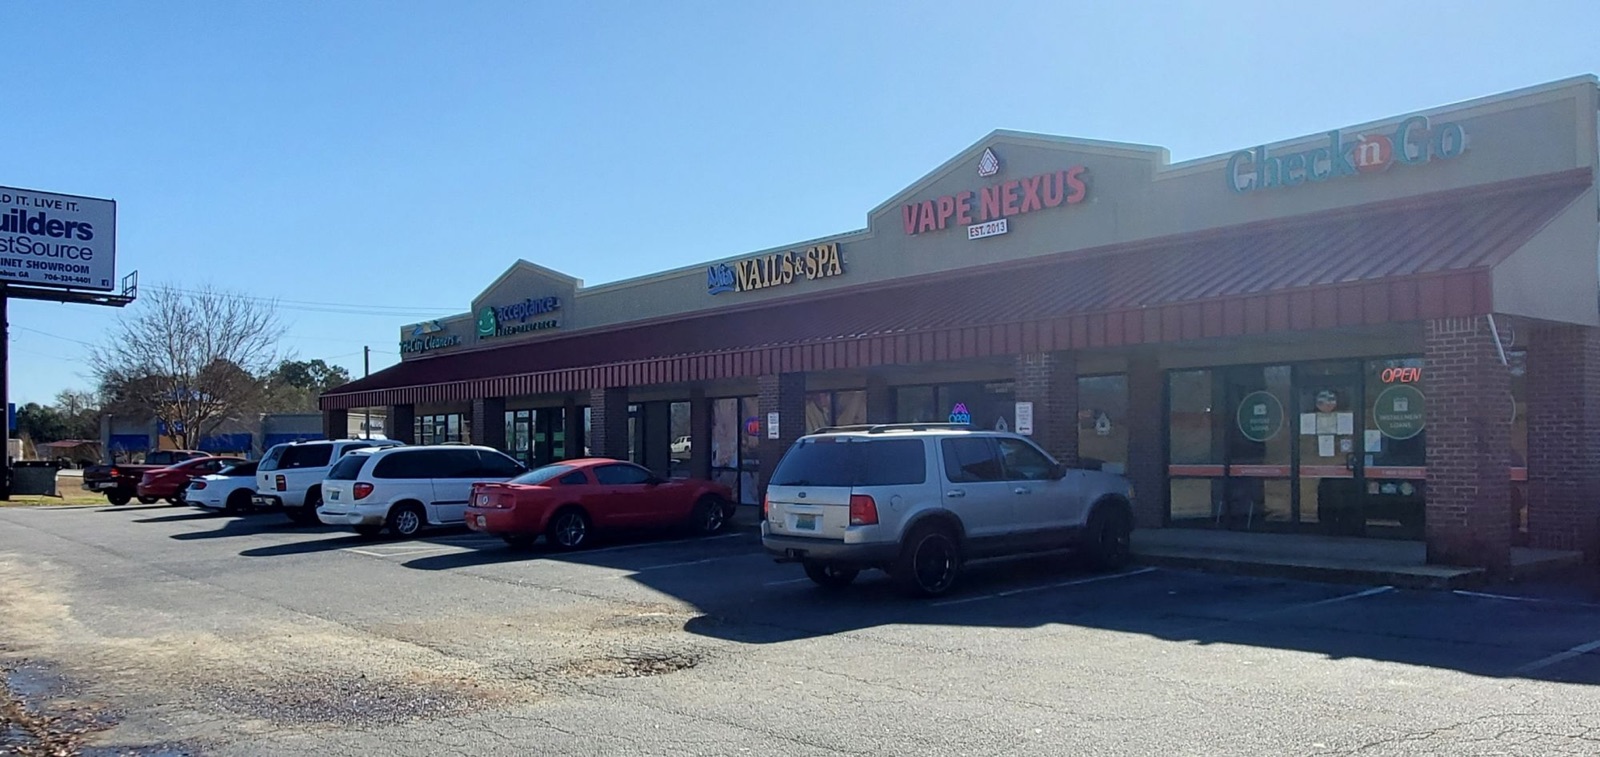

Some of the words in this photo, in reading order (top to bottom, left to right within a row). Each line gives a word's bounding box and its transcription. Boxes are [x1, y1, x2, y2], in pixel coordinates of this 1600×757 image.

[1226, 129, 1359, 194] Check
[1396, 115, 1466, 165] Go
[16, 196, 30, 206] IT.
[34, 198, 63, 210] LIVE
[66, 202, 80, 212] IT.
[901, 191, 973, 235] VAPE
[980, 166, 1087, 221] NEXUS
[969, 225, 985, 239] EST.
[986, 222, 1006, 236] 2013
[18, 271, 29, 279] GA
[26, 260, 90, 275] SHOWROOM
[735, 250, 795, 292] NAILS
[794, 256, 805, 276] &
[805, 242, 843, 280] SPA
[497, 297, 553, 322] acceptance
[1380, 367, 1422, 384] OPEN
